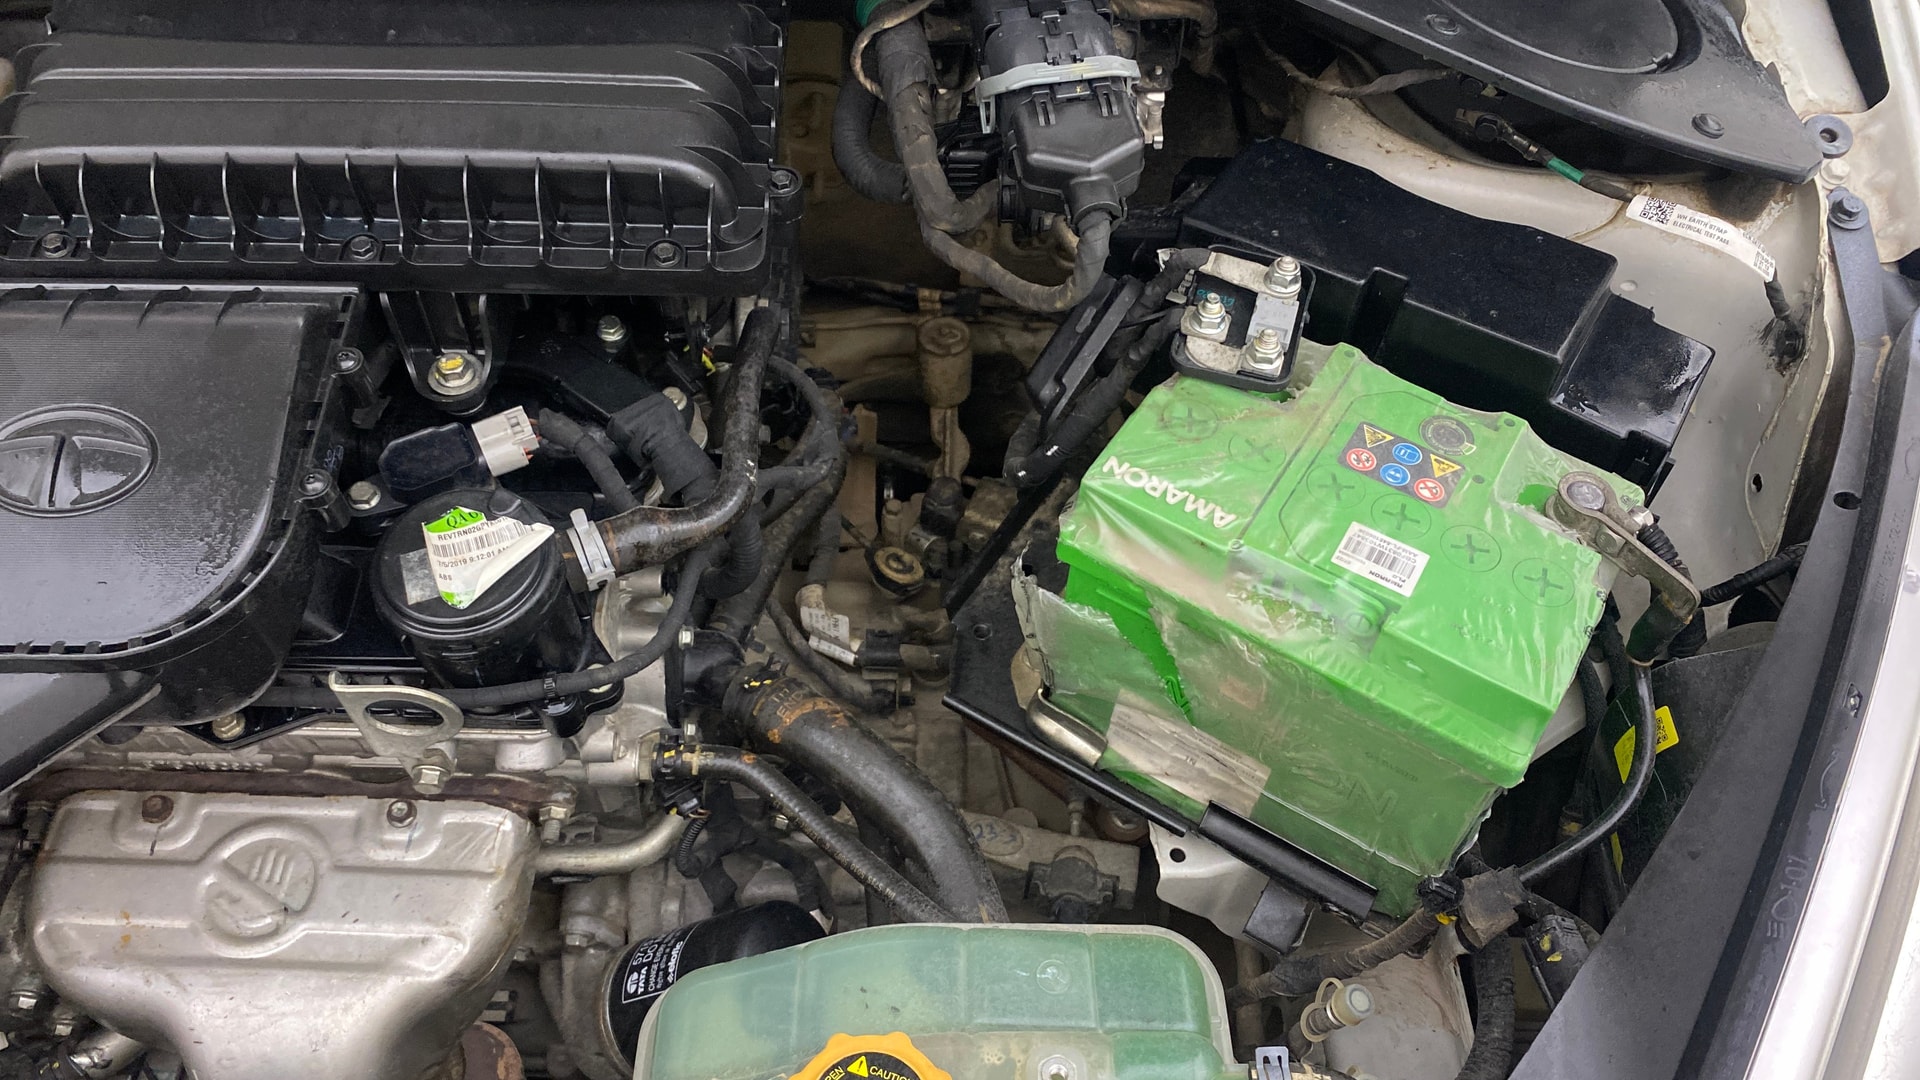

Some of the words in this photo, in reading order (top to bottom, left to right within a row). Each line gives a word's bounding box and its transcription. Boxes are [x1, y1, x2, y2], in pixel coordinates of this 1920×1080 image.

[1672, 221, 1703, 235] ELECTRICAL
[1703, 229, 1717, 241] TEST
[1688, 216, 1708, 227] EARTH
[1709, 223, 1729, 235] STRAP
[1102, 455, 1237, 528] AMARON
[446, 514, 467, 529] QA
[1369, 570, 1403, 588] AMARON
[667, 940, 683, 973] elofic
[638, 966, 648, 995] TATA
[648, 963, 659, 991] CHANGE
[824, 1066, 844, 1080] PEN
[870, 1066, 912, 1080] CAUTIO
